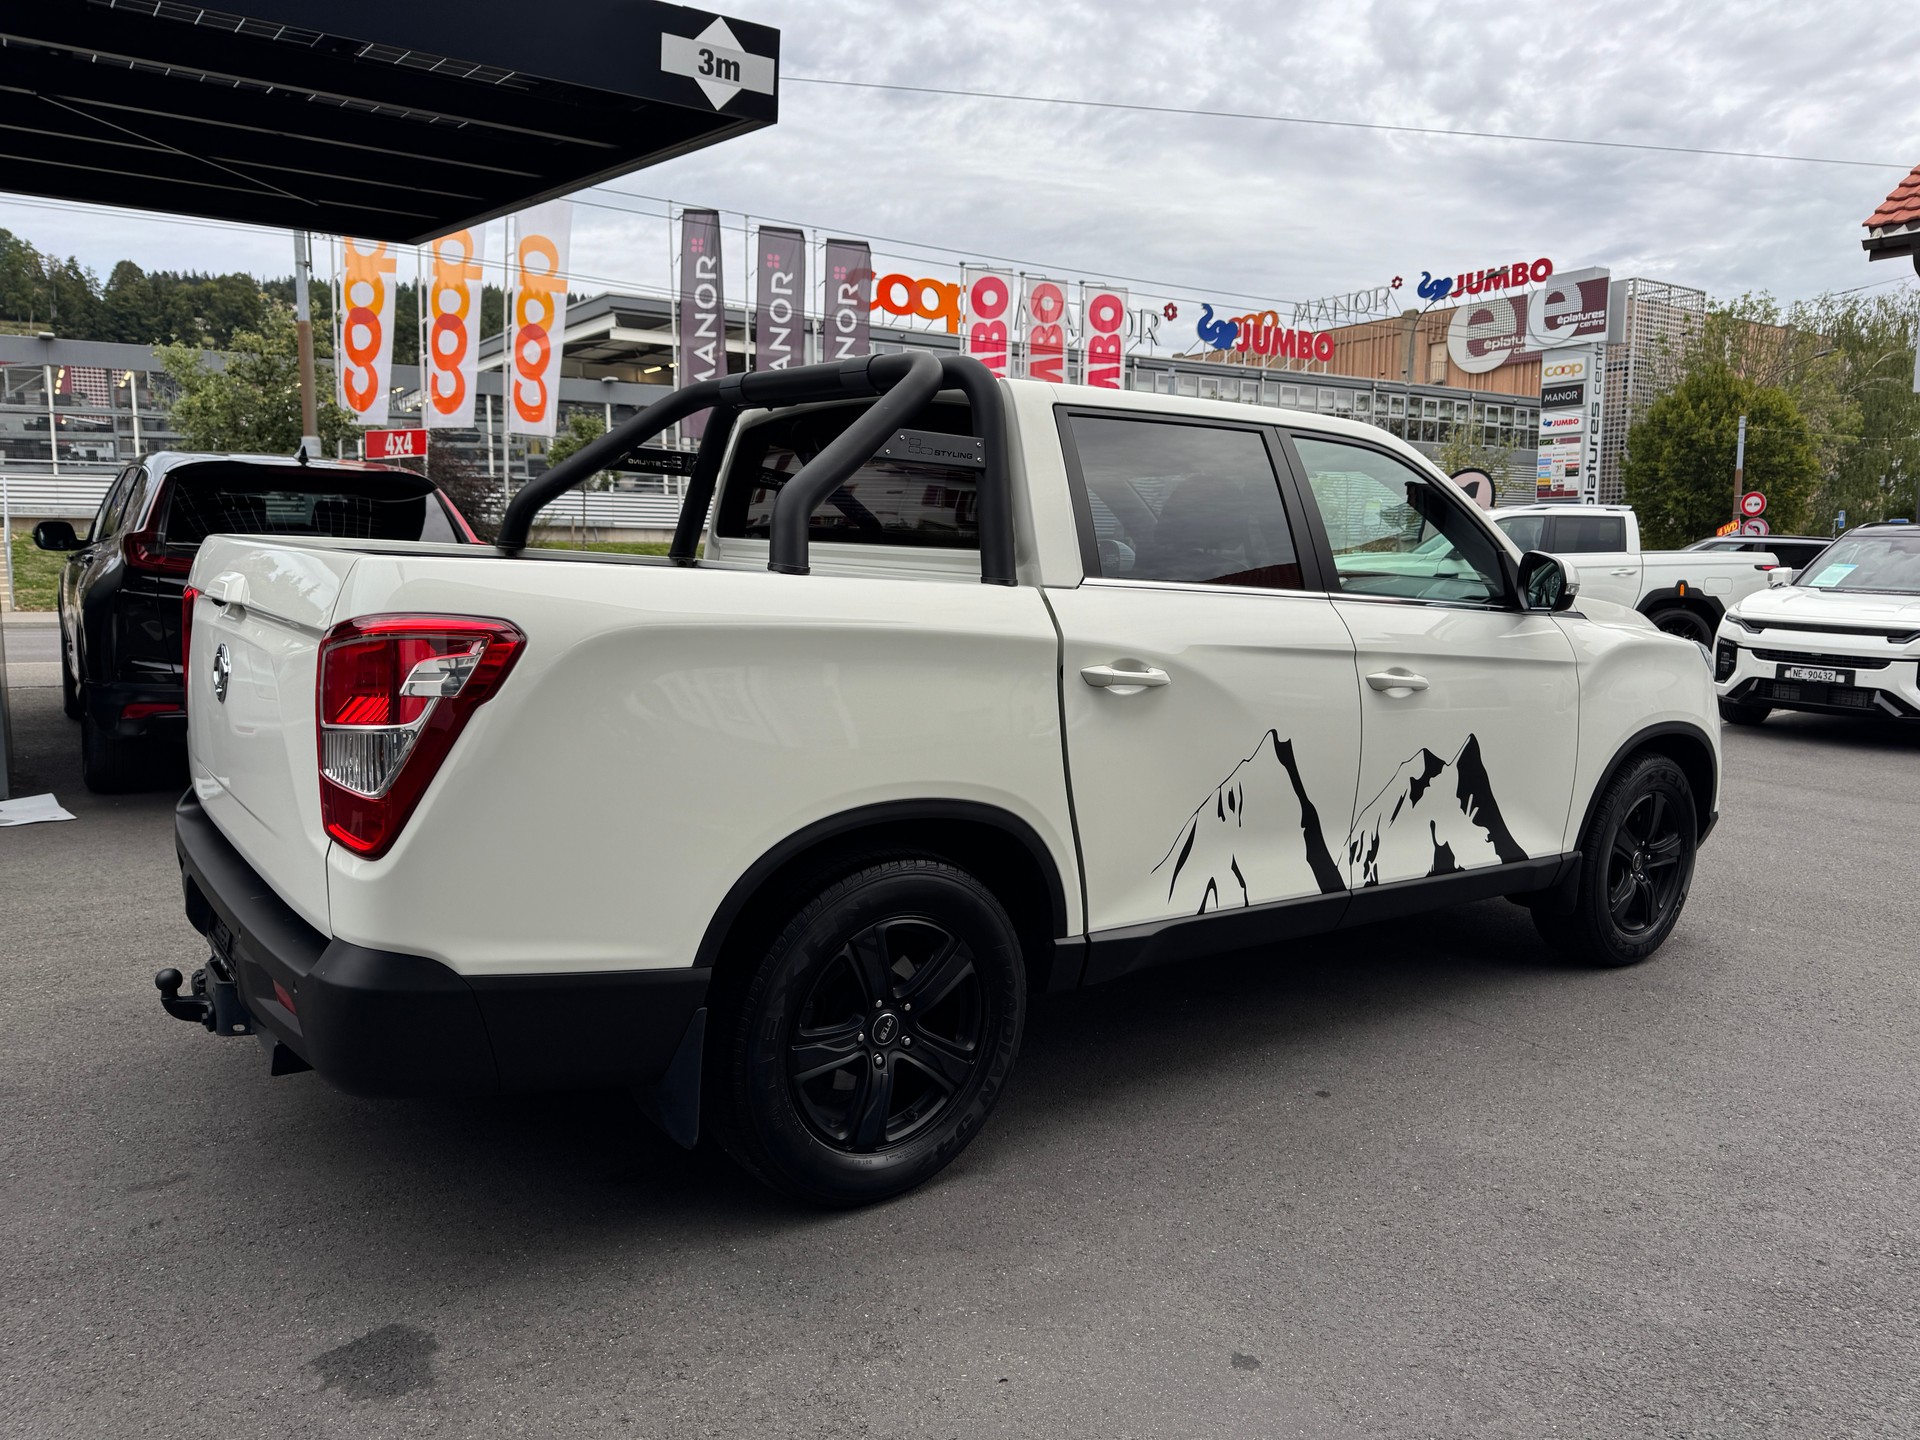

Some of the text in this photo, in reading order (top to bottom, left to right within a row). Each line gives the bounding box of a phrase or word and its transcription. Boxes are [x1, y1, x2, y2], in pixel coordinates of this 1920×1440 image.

[698, 48, 740, 82] 3m
[1451, 258, 1553, 298] JUMBO
[1293, 286, 1389, 326] MANOR
[430, 229, 483, 415] coop
[513, 234, 568, 423] coop
[1235, 322, 1335, 362] JUMBO
[1544, 363, 1583, 377] coop
[1544, 390, 1578, 402] MANOR
[1552, 418, 1579, 427] JUMBO
[385, 432, 413, 455] 4x4
[934, 449, 973, 460] STYLING
[1793, 669, 1833, 680] NE 90432
